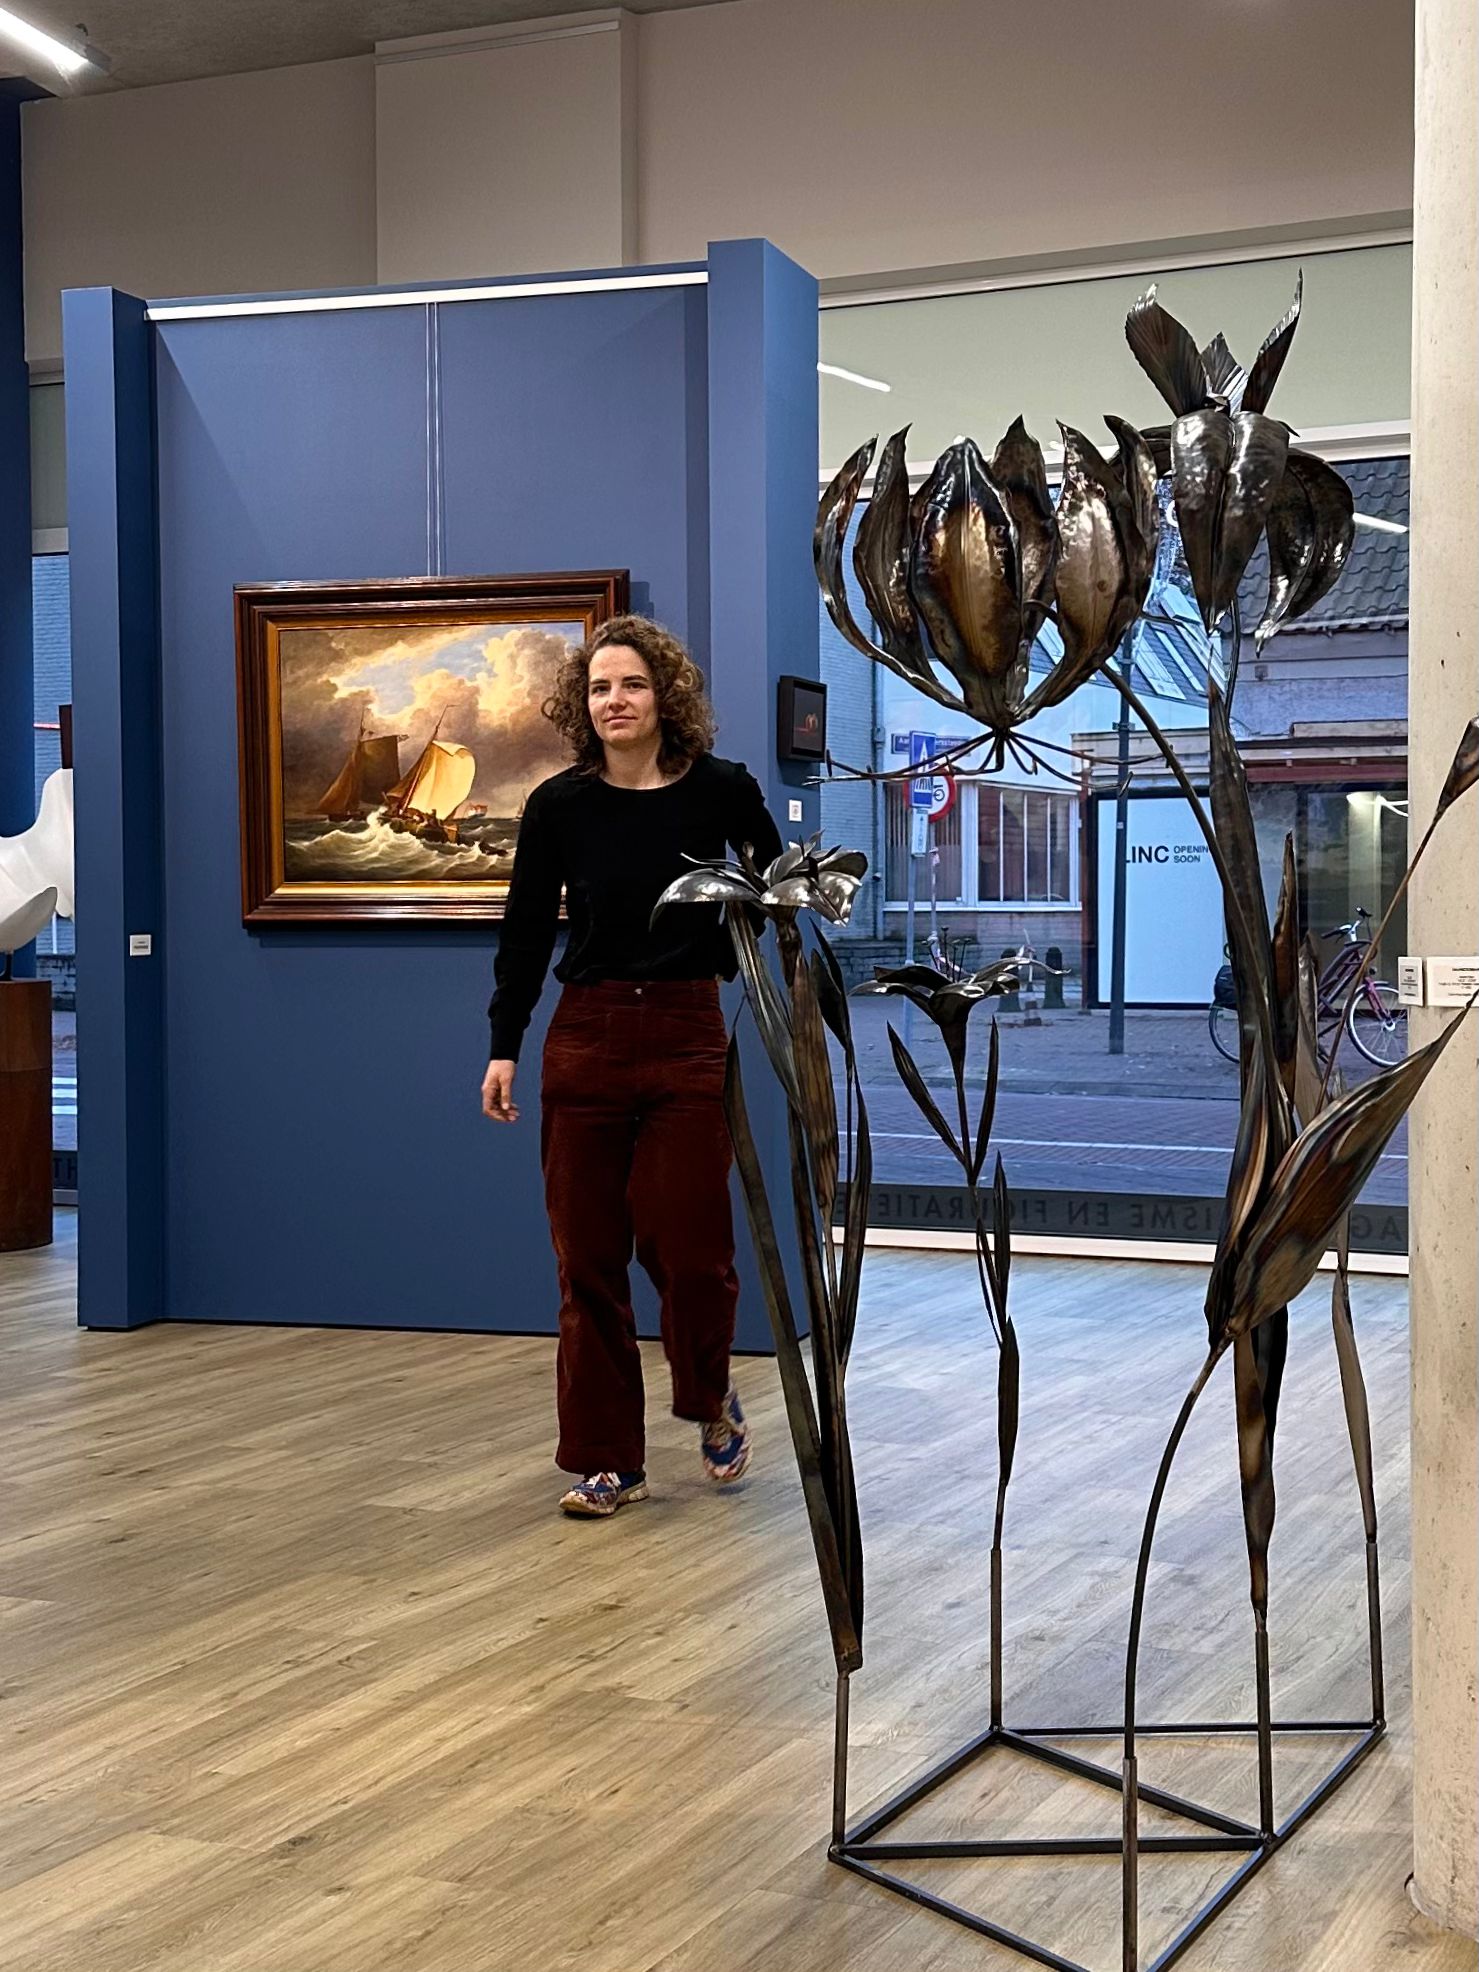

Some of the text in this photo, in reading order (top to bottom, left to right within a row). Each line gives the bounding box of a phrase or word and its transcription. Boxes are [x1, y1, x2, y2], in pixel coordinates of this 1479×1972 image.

[1173, 845, 1209, 854] OPENIN
[1125, 845, 1169, 864] INC
[1173, 855, 1201, 864] SOON
